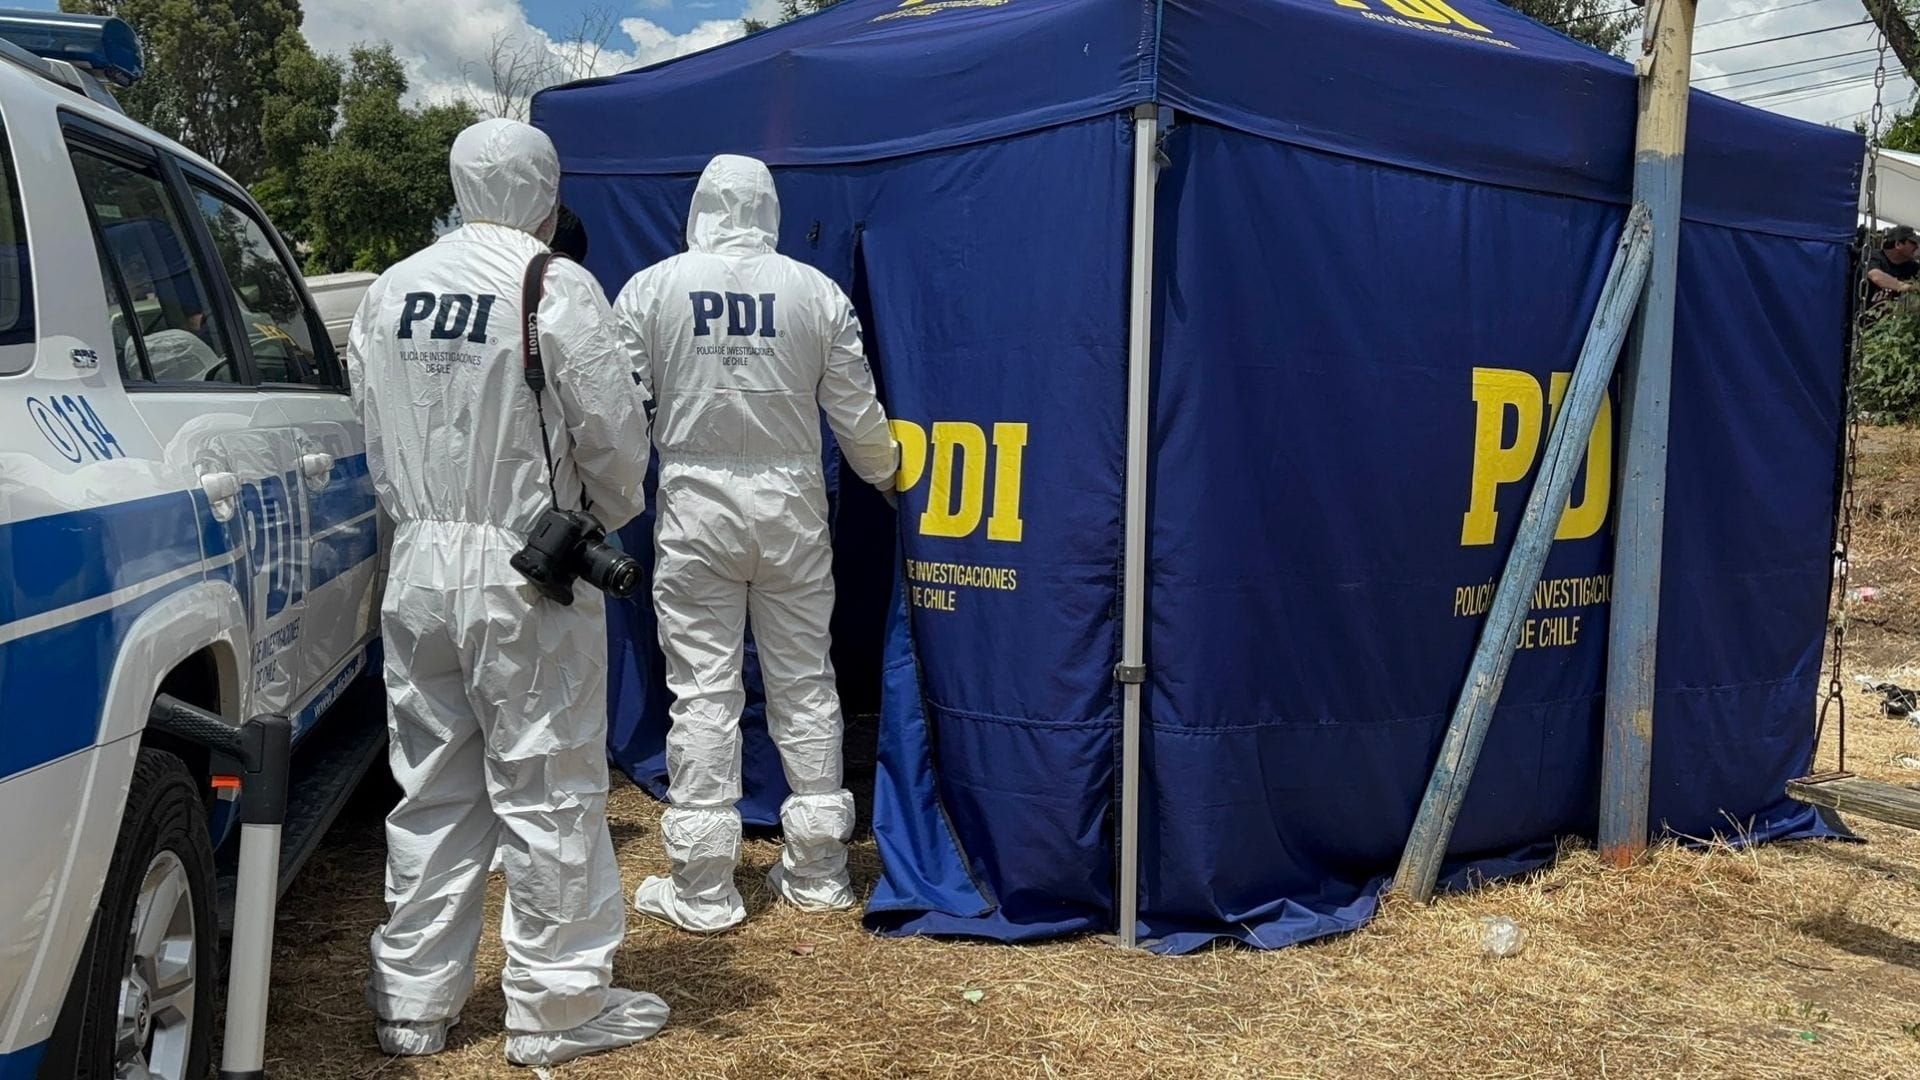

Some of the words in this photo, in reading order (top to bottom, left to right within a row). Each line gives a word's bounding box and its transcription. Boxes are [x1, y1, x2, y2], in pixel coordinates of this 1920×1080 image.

[397, 292, 496, 344] PDI
[689, 291, 776, 338] PDI
[528, 312, 538, 355] Canon
[420, 351, 429, 362] DE
[722, 357, 731, 366] DE
[1460, 367, 1613, 546] PD
[916, 561, 1017, 591] INVESTIGACIONES
[1531, 574, 1611, 609] NVESTIGACI
[924, 588, 956, 611] CHILE
[1539, 616, 1580, 647] CHILE
